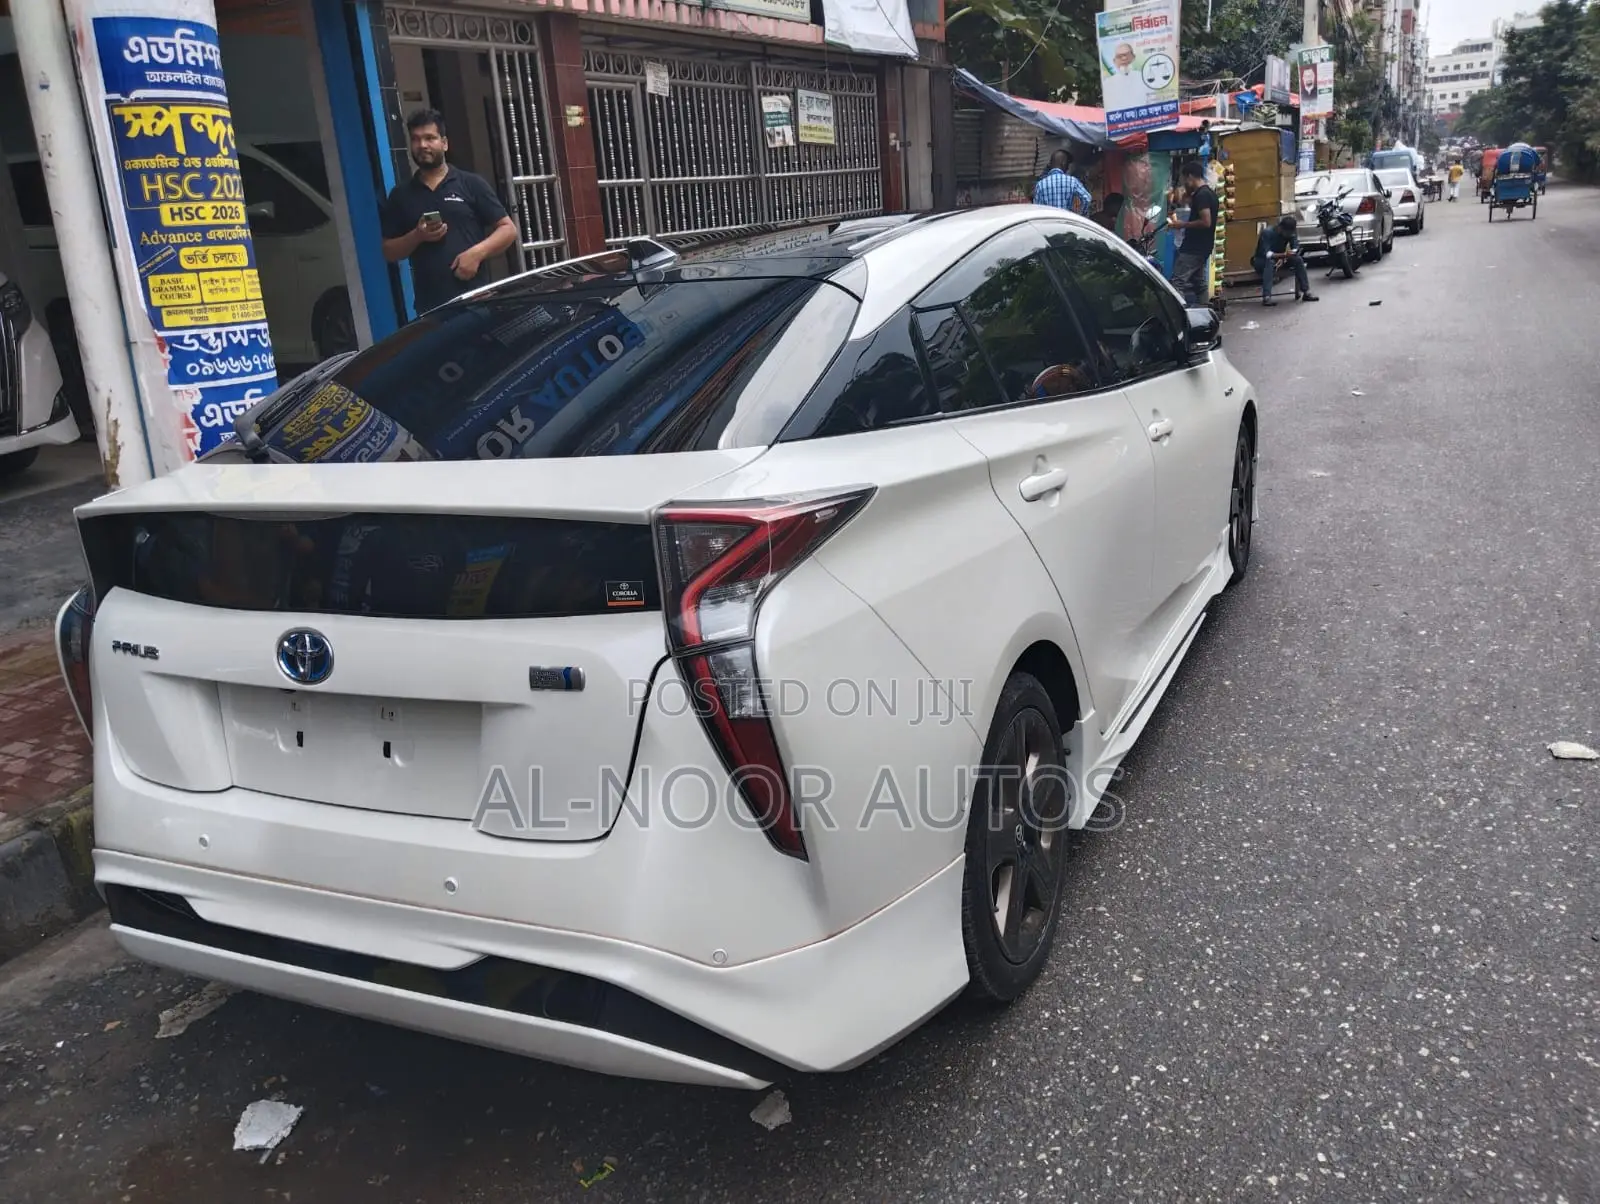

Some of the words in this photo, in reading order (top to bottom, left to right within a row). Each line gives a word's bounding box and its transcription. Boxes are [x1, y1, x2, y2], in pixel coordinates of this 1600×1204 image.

[140, 172, 205, 202] HSC
[208, 173, 245, 199] 202
[169, 206, 206, 221] HSC
[211, 205, 241, 220] 2026
[140, 229, 203, 245] Advance
[160, 277, 184, 285] BASIC
[152, 284, 196, 293] GRAMMAR
[160, 292, 193, 300] COURSE
